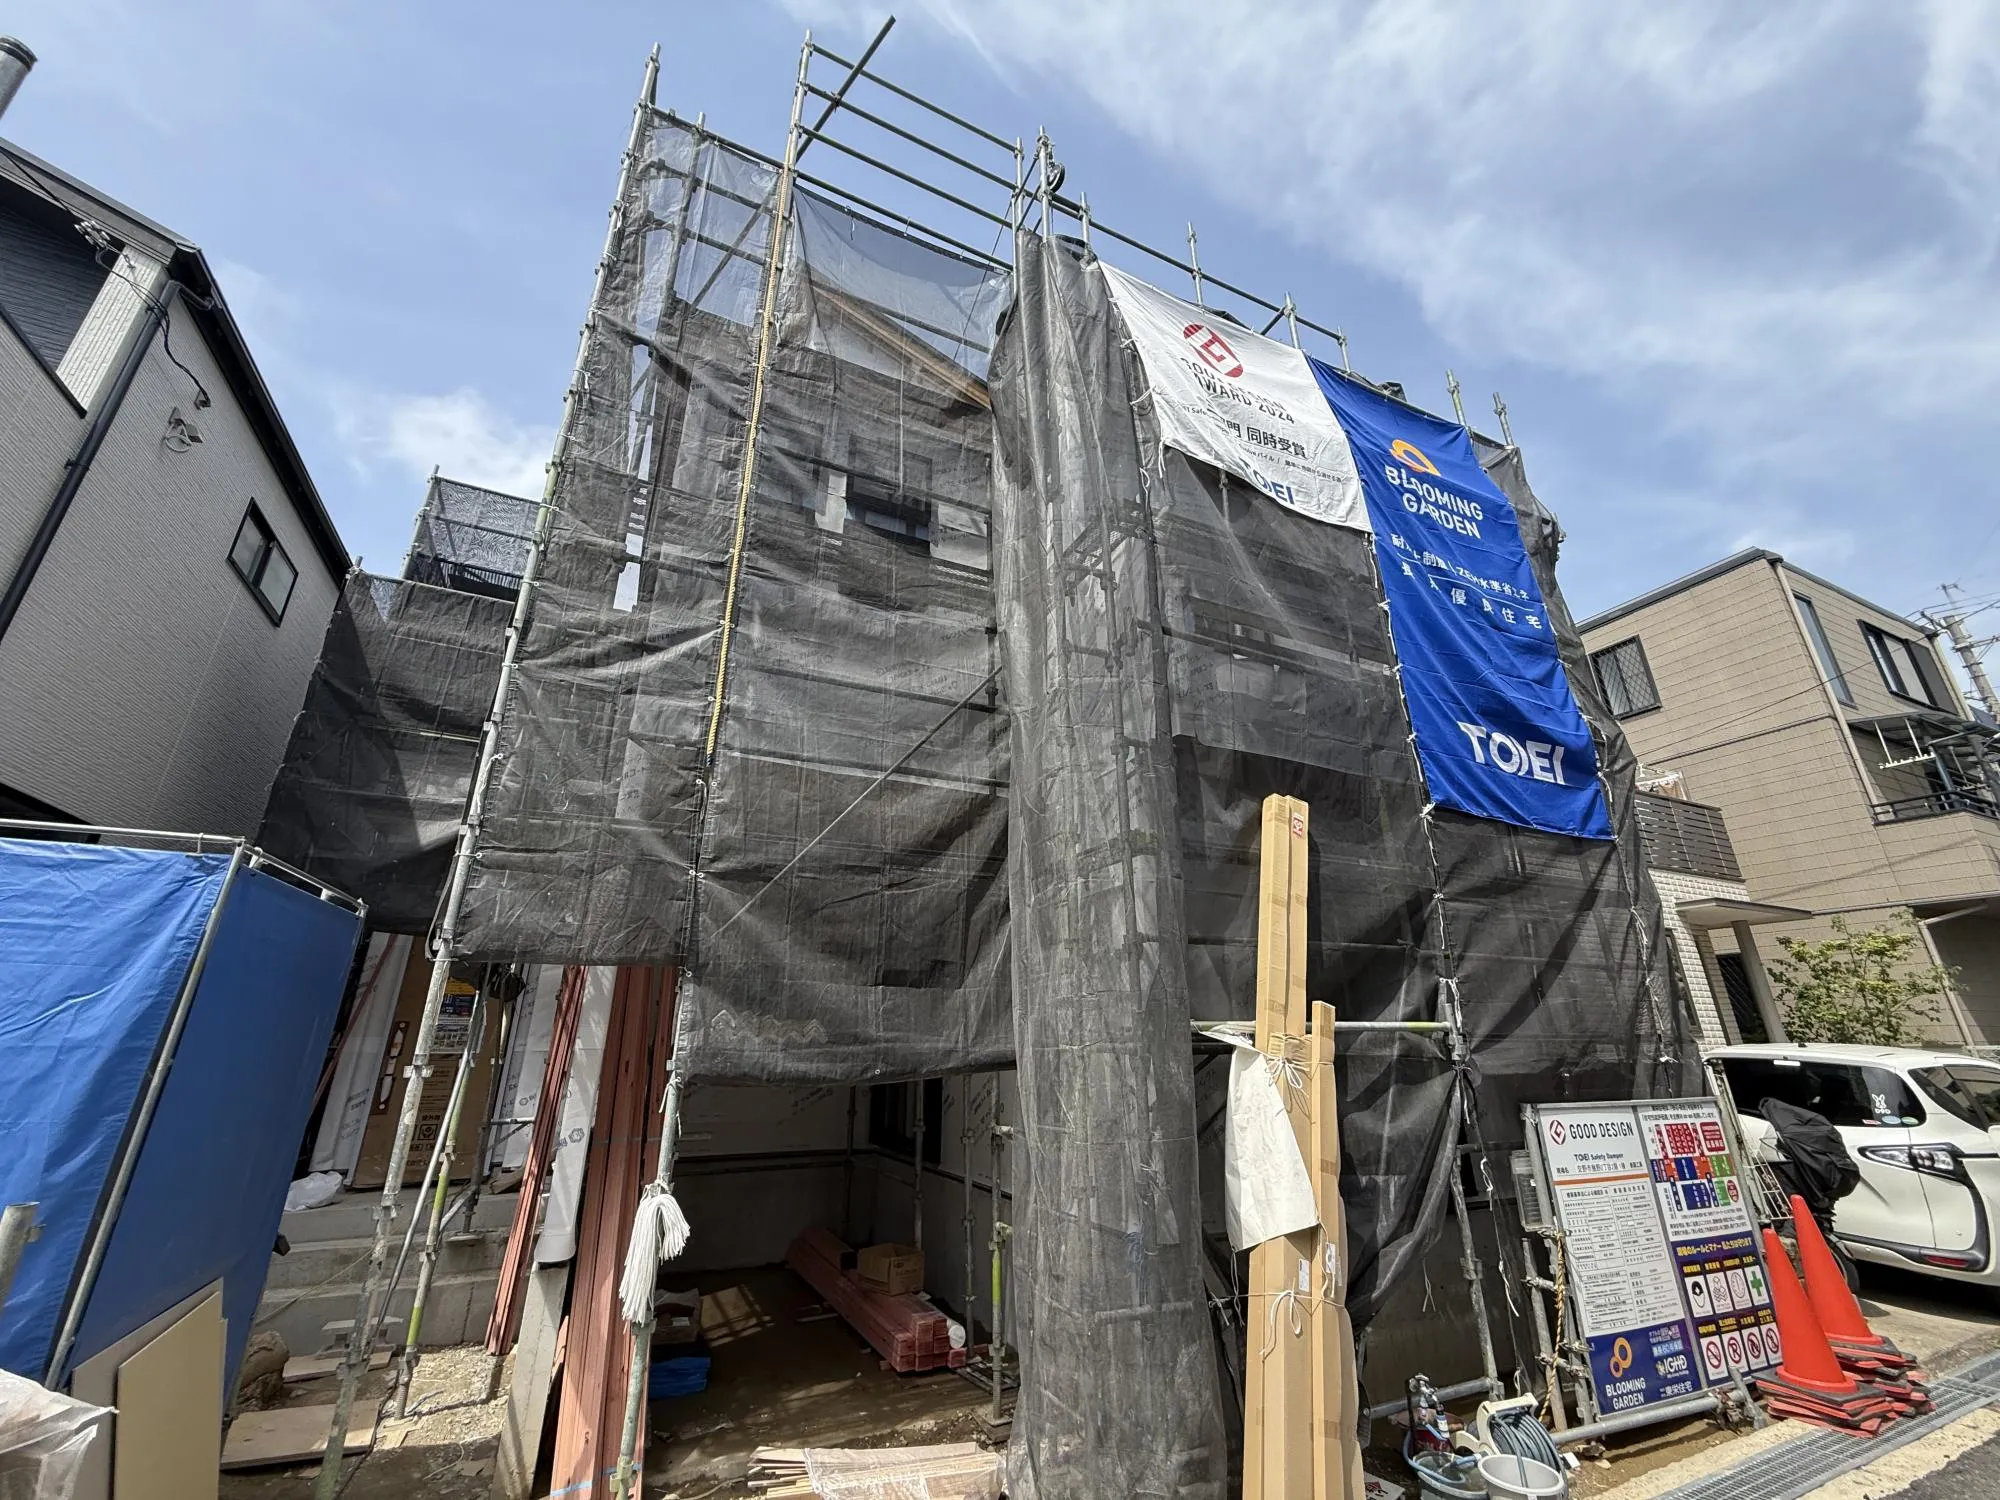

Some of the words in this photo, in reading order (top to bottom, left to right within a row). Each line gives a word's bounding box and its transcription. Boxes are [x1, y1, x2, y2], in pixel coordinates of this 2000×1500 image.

[1385, 464, 1484, 520] BLOOMING
[1402, 493, 1481, 539] GARDEN
[1457, 721, 1565, 785] TOEI
[1569, 1123, 1597, 1139] GOOD
[1599, 1122, 1634, 1137] DESIGN
[1605, 1377, 1646, 1397] BLOOMING
[1612, 1392, 1645, 1410] GARDEN
